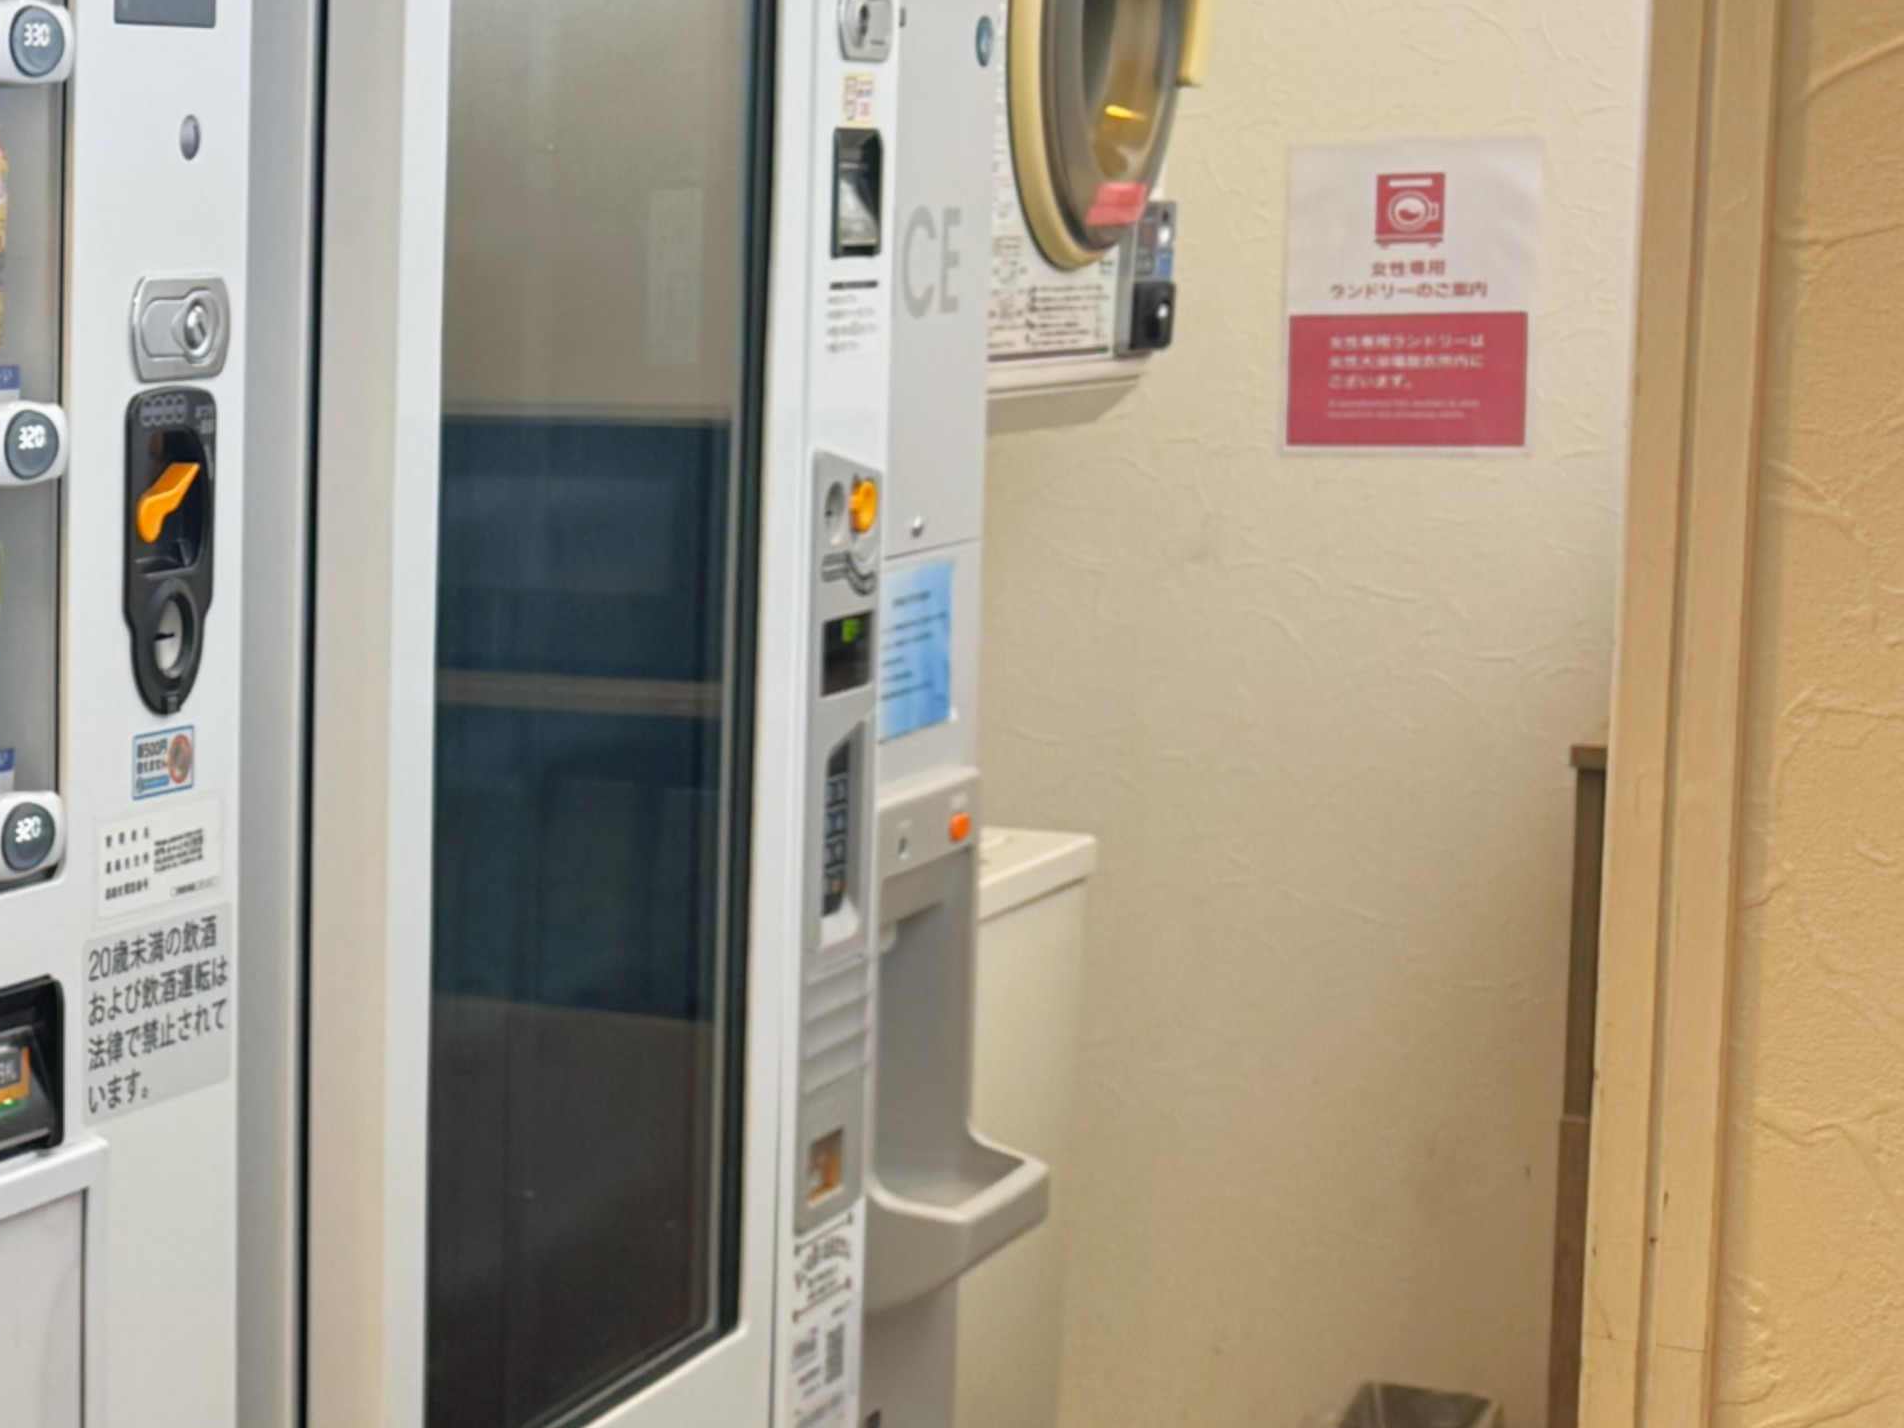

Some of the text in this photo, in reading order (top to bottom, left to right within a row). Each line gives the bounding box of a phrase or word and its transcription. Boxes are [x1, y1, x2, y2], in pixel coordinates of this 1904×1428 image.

[22, 24, 51, 47] 330
[1371, 260, 1447, 278] 女性専用
[1330, 282, 1487, 300] ランドリーのご案内
[13, 816, 42, 842] 320
[88, 915, 217, 981] 20歳未満の飲酒
[88, 955, 229, 1027] および飲酒運転は
[88, 997, 228, 1072] 法律で禁止されて
[88, 1067, 150, 1114] います。
